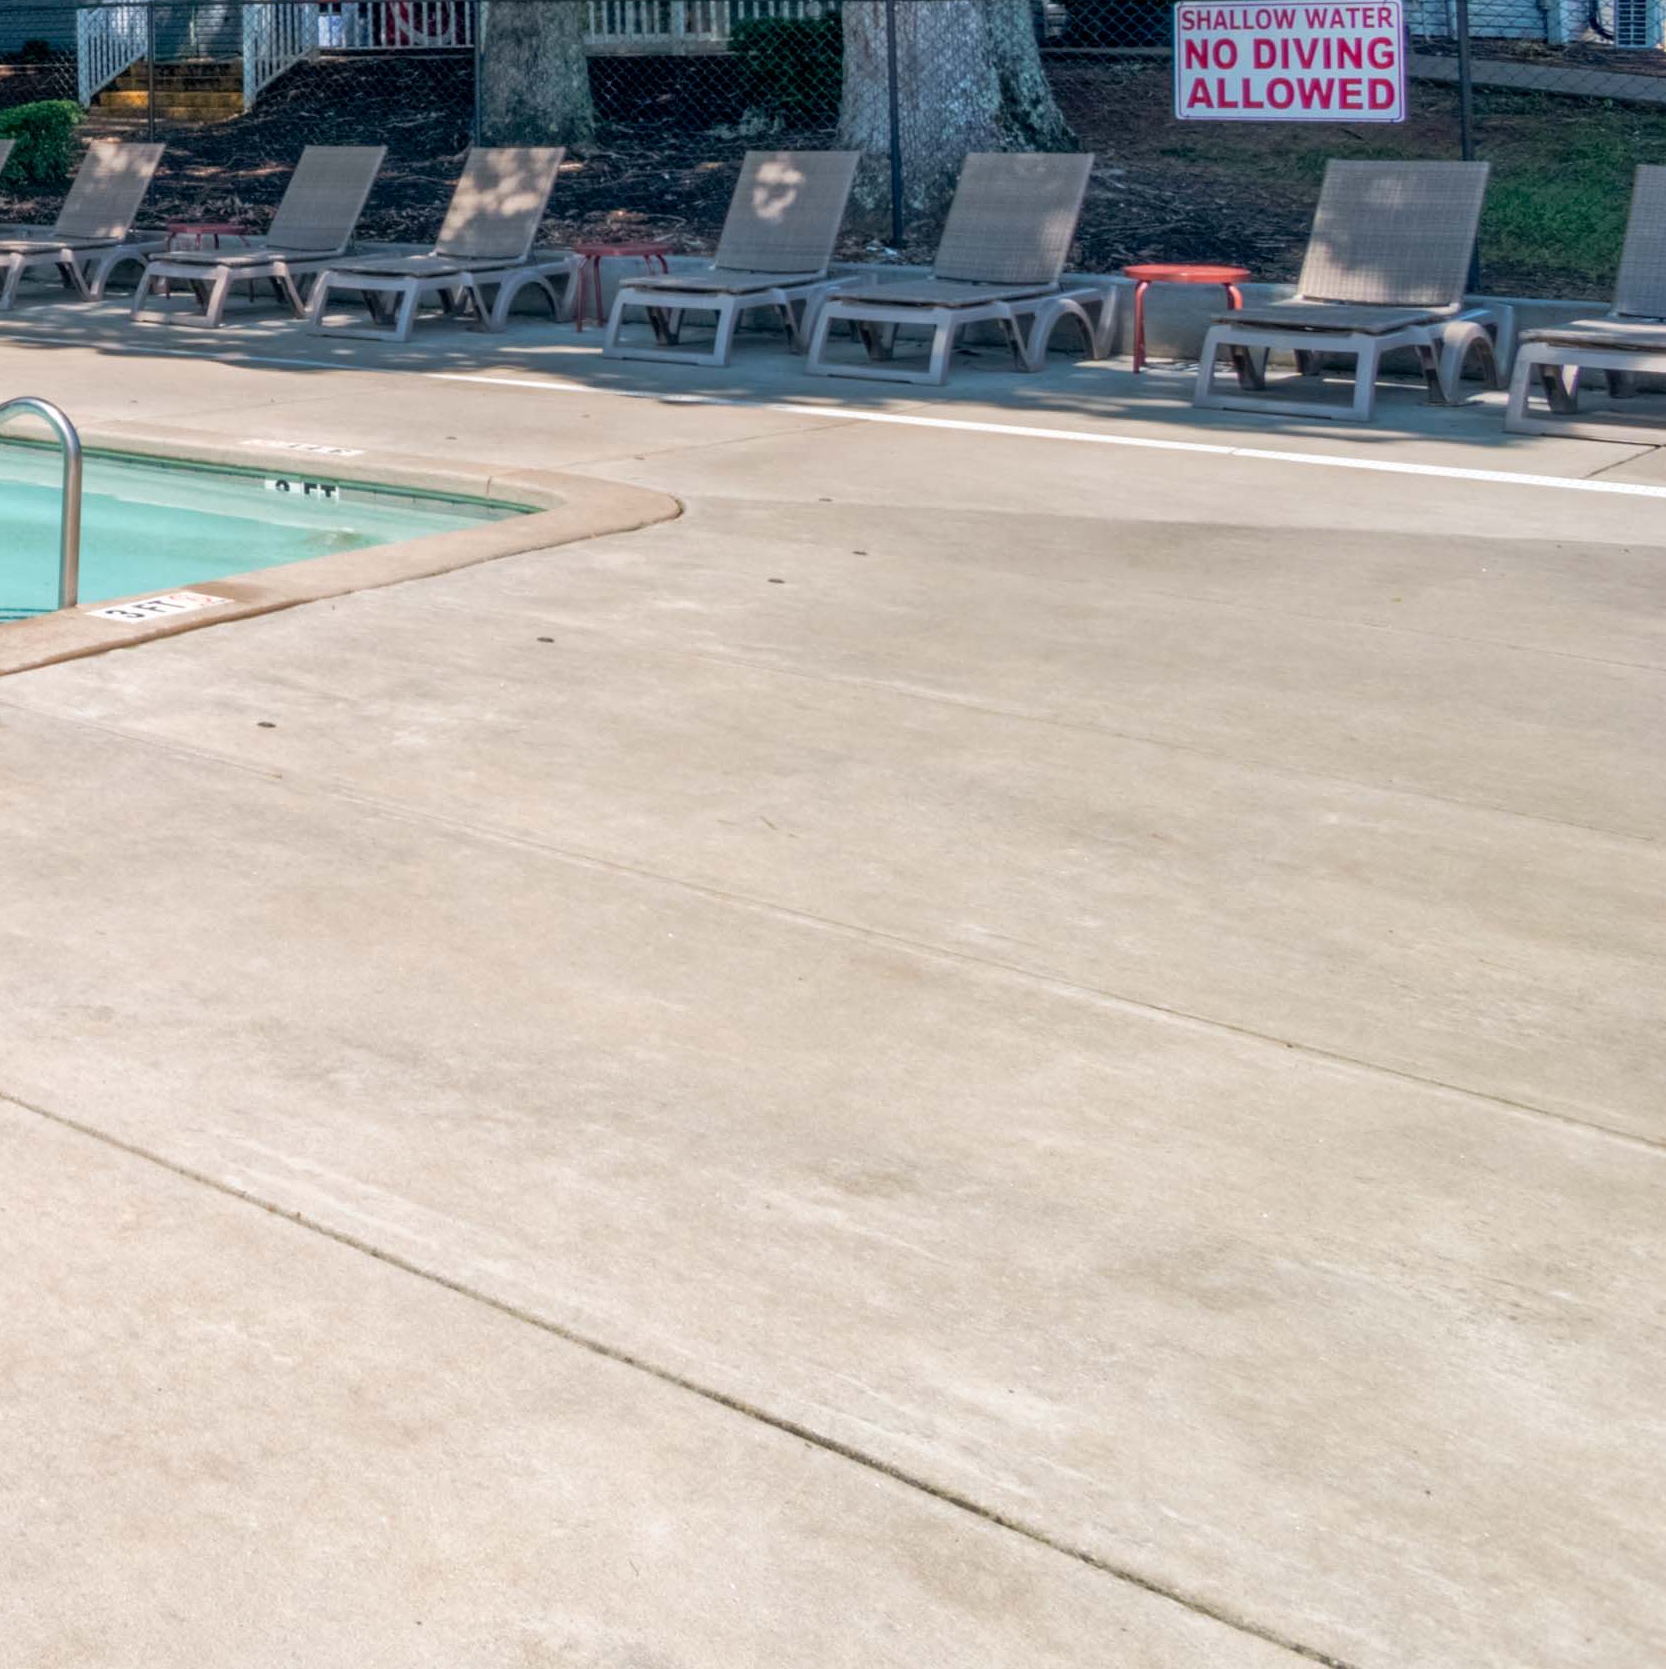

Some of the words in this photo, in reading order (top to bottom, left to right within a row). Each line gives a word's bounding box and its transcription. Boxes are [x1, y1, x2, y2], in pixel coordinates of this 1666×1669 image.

[1181, 8, 1296, 31] SHALLOW
[1304, 7, 1394, 29] WATER
[1185, 37, 1238, 70] NO
[1253, 37, 1395, 70] DIVING
[1187, 77, 1395, 110] ALLOWED
[105, 609, 146, 619] 3
[131, 599, 187, 613] FT
